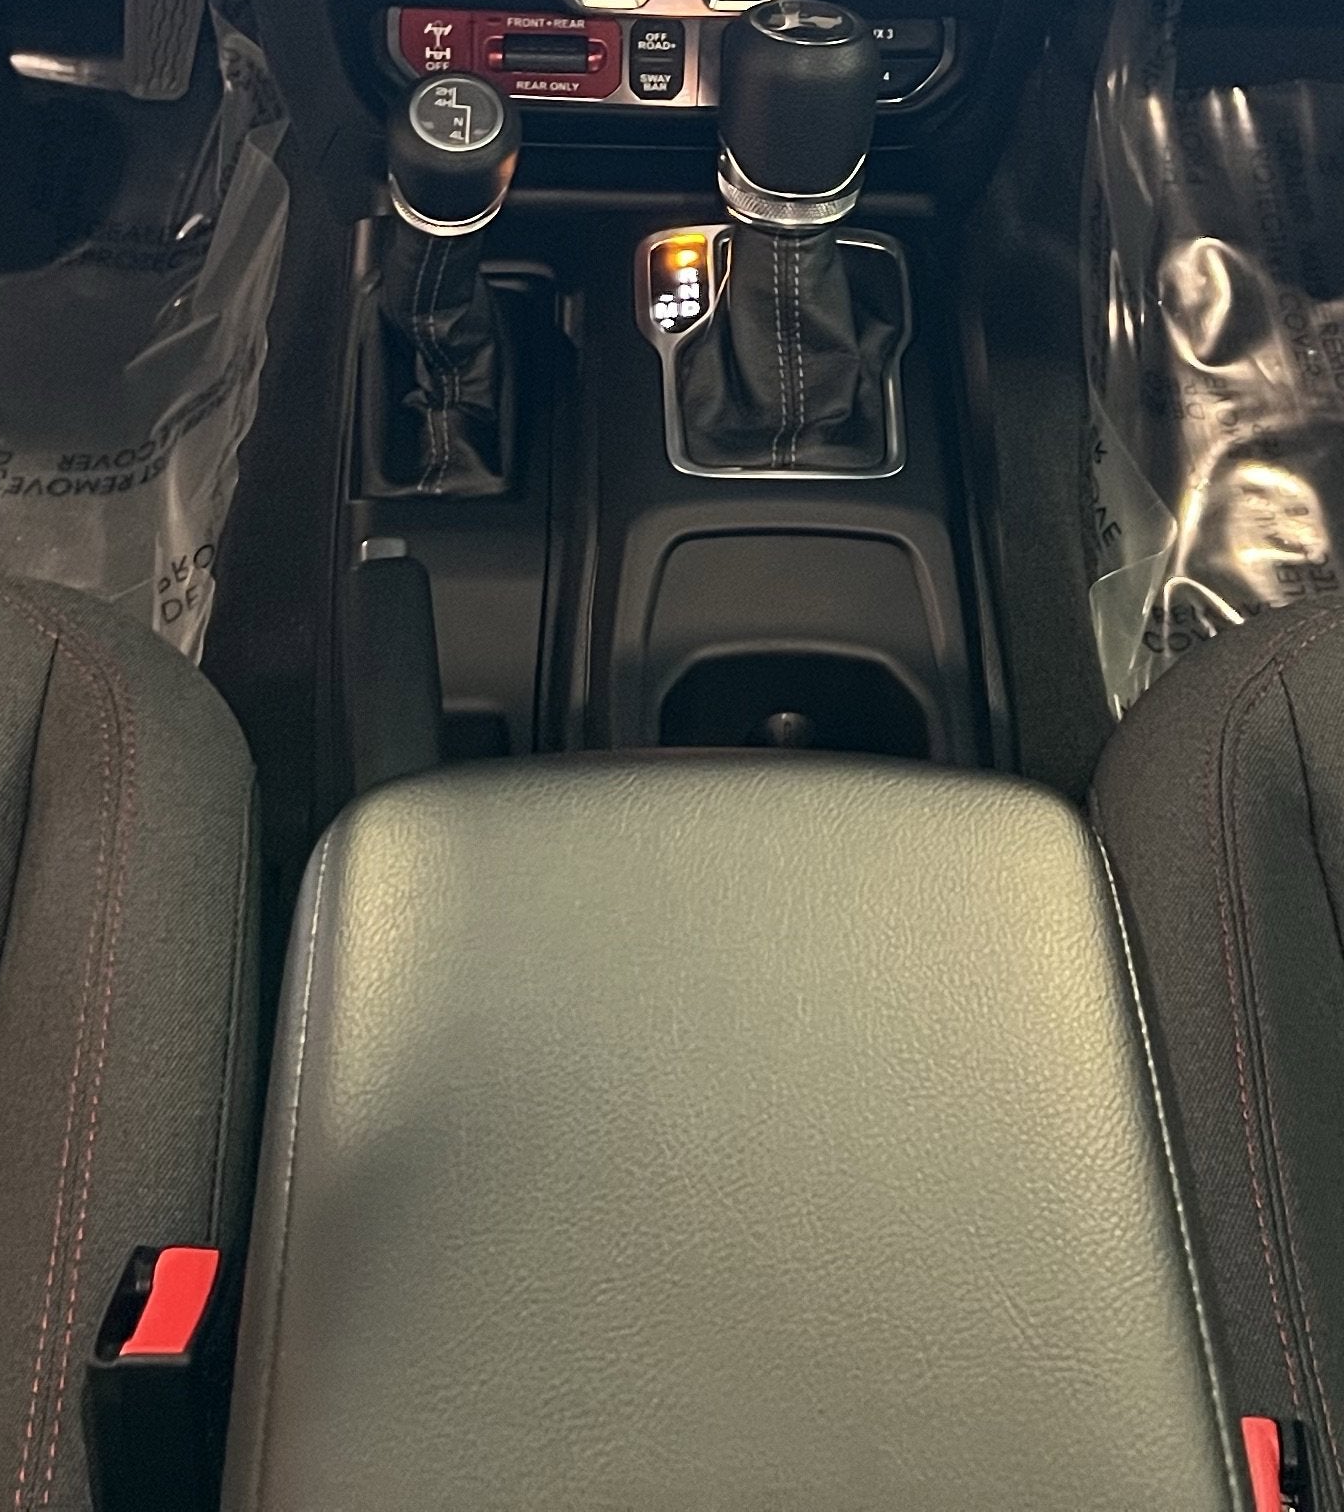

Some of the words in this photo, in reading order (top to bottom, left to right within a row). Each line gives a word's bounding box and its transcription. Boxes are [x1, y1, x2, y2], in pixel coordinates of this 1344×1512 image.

[645, 33, 668, 42] OFF
[425, 61, 450, 71] OFF
[640, 74, 672, 83] SWAY
[883, 71, 891, 81] 4
[516, 80, 548, 90] REAR
[549, 81, 580, 92] ONLY
[453, 117, 464, 126] N
[449, 130, 465, 140] 4L
